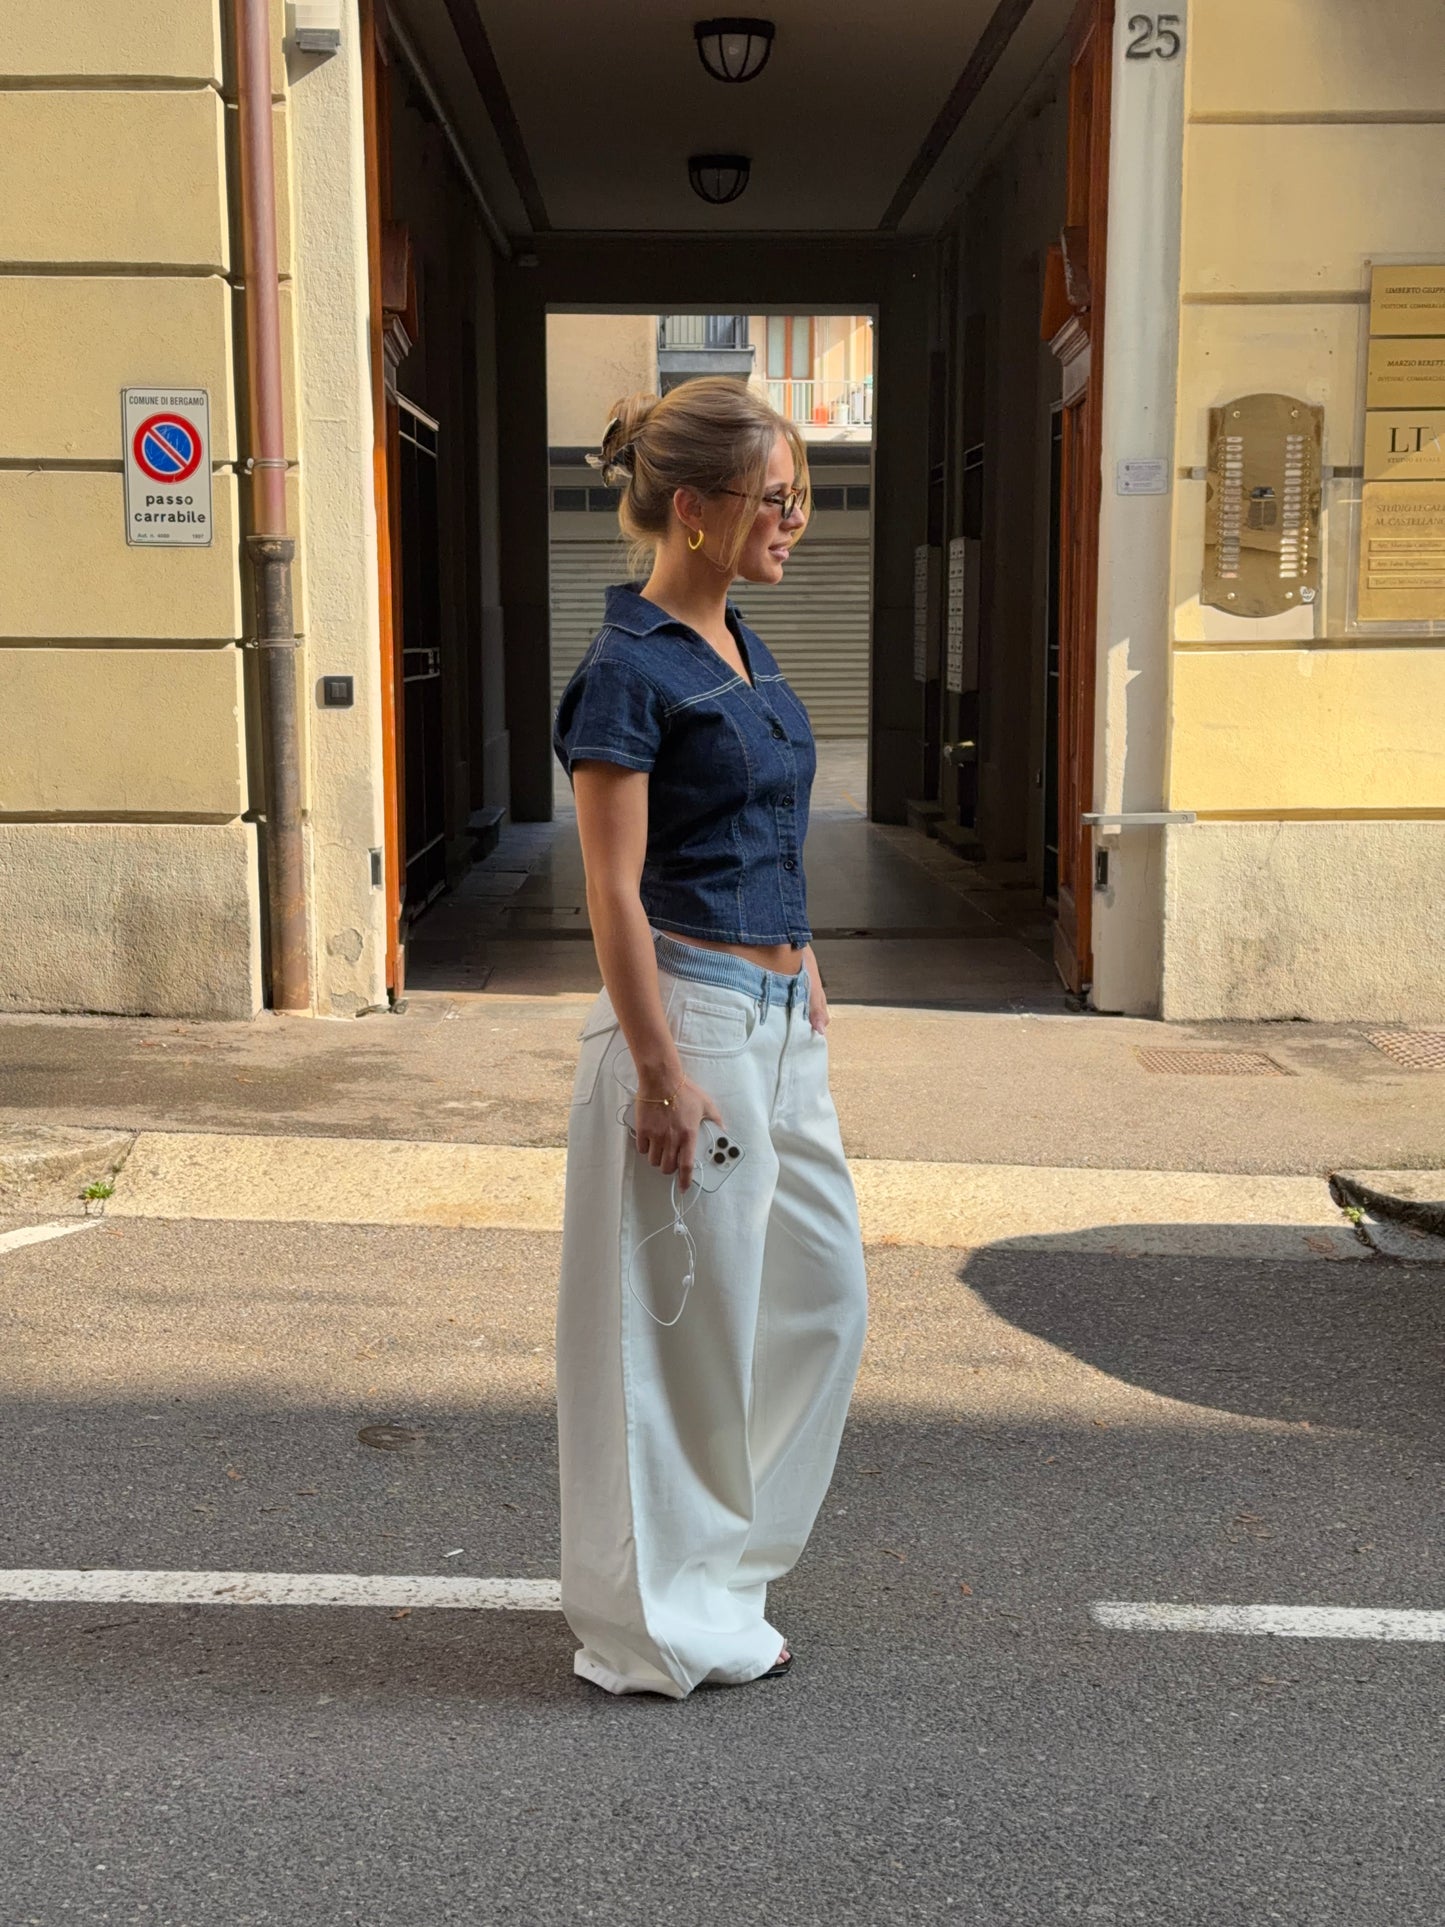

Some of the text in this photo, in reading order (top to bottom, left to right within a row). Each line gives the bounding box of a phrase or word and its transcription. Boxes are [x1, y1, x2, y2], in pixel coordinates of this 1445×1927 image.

[1125, 14, 1180, 59] 25
[129, 396, 204, 406] COMUNE DI BERGAMO
[146, 495, 193, 506] passo
[1376, 504, 1411, 512] STUDIO
[134, 511, 206, 523] carrabile
